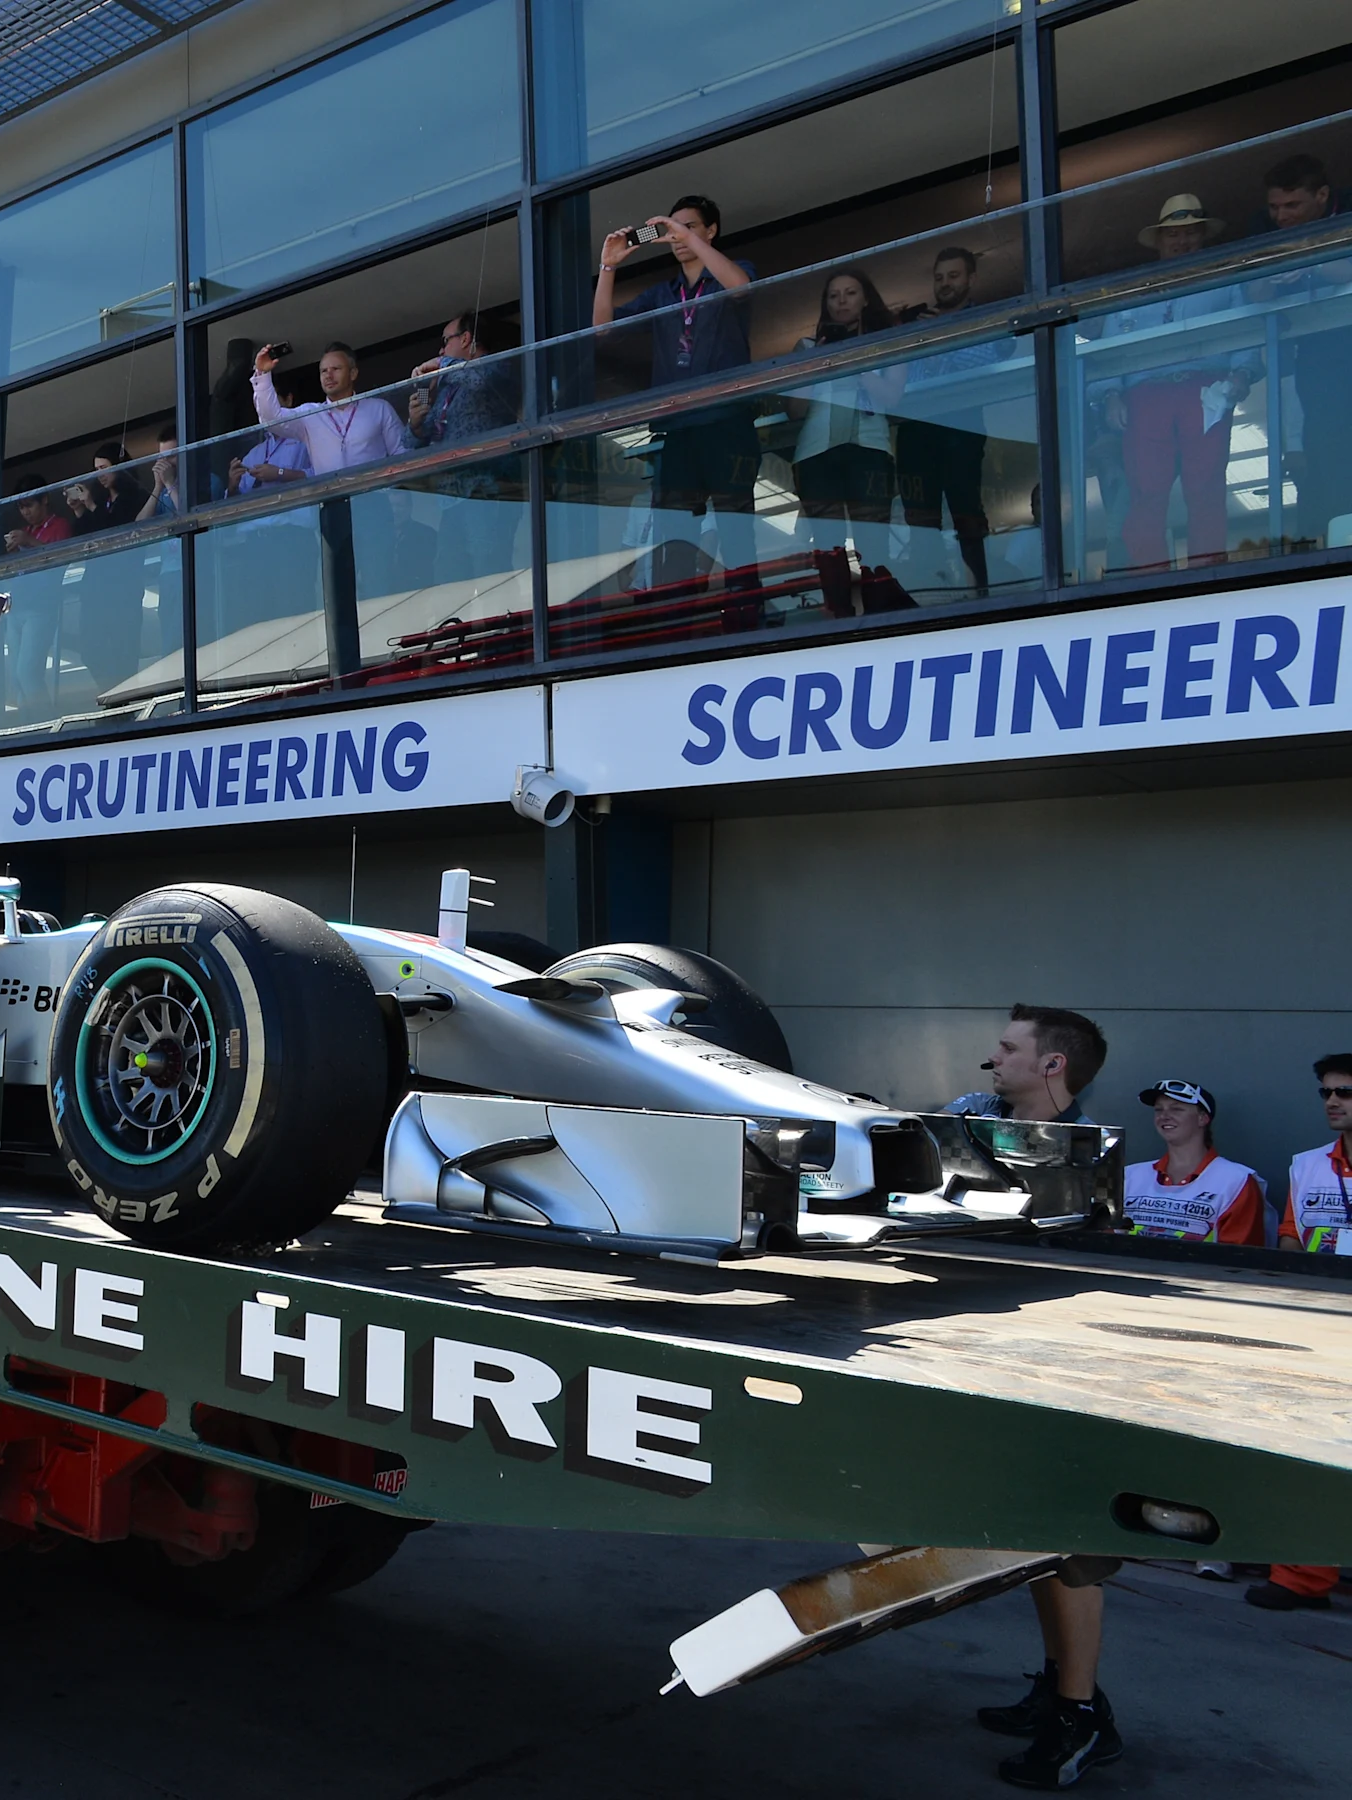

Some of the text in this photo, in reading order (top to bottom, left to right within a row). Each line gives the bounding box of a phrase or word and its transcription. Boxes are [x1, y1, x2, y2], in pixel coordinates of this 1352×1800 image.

[12, 721, 429, 827] SCRUTINEERING
[104, 913, 202, 948] PIRELLI
[66, 1158, 180, 1223] ZERO
[1188, 1203, 1210, 1216] 2014
[239, 1300, 713, 1485] HIRE
